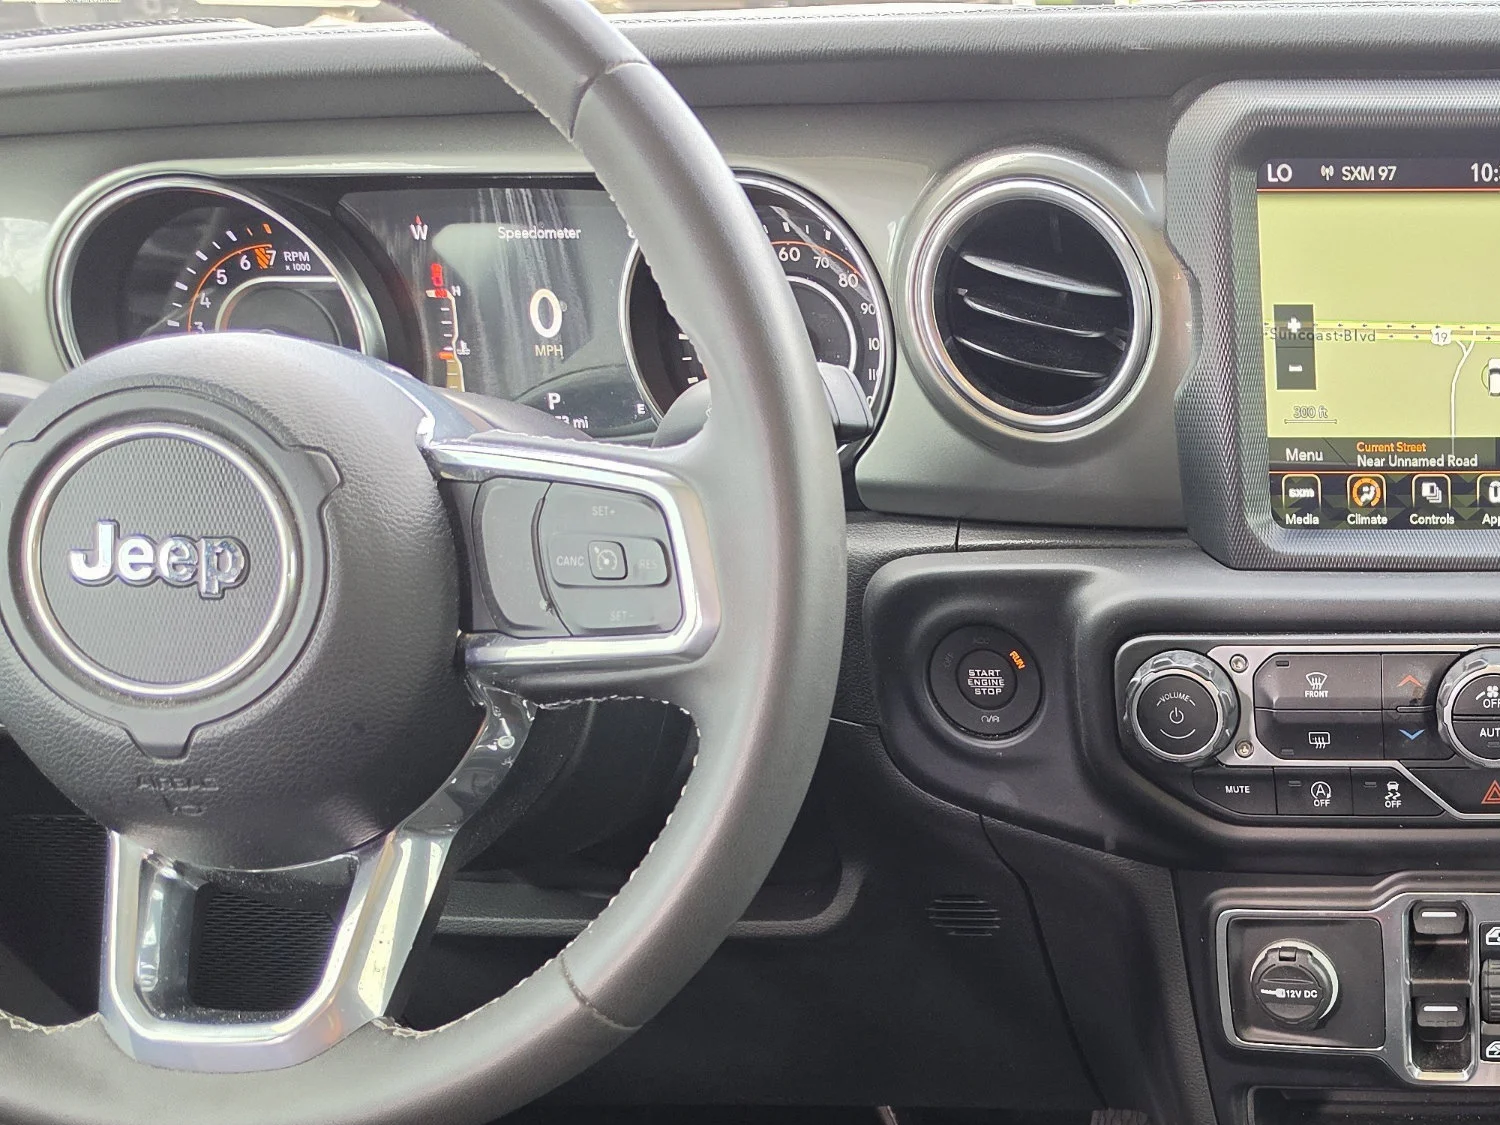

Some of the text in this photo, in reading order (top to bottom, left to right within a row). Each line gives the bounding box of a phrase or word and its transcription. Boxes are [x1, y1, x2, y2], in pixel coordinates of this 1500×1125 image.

[1267, 163, 1293, 183] LO
[1341, 166, 1397, 181] SXM 97
[410, 224, 428, 241] W
[497, 226, 582, 242] Speedometer
[266, 250, 277, 265] 7
[284, 251, 310, 262] RPM
[778, 247, 801, 262] 60
[239, 255, 251, 270] 6
[813, 256, 830, 269] 70
[216, 269, 228, 285] 5
[838, 273, 859, 288] 80
[200, 293, 211, 308] 4
[529, 288, 563, 338] 0
[860, 303, 876, 315] 90
[1270, 327, 1376, 342] Suncoast Blvd
[1434, 332, 1448, 342] 19
[535, 344, 563, 356] MPH
[868, 337, 880, 351] 10
[548, 392, 561, 410] P
[1293, 406, 1329, 419] 300 ft
[572, 416, 589, 429] mi
[1356, 442, 1427, 453] Current Street
[1285, 448, 1324, 462] Menu
[1357, 454, 1478, 467] Near Unnamed Road
[1285, 513, 1320, 525] Media
[1347, 513, 1388, 525] Climate
[1409, 513, 1455, 525] Controls
[69, 519, 250, 599] Jeep
[556, 555, 585, 566] CANC
[968, 669, 1001, 677] START
[967, 678, 1005, 686] ENGINE
[1159, 692, 1190, 702] VOLUME
[1305, 690, 1329, 698] FRONT
[1225, 785, 1250, 794] MUTE
[1313, 800, 1330, 808] OFF
[1385, 800, 1402, 809] OFF
[1285, 989, 1318, 998] 12V DC
